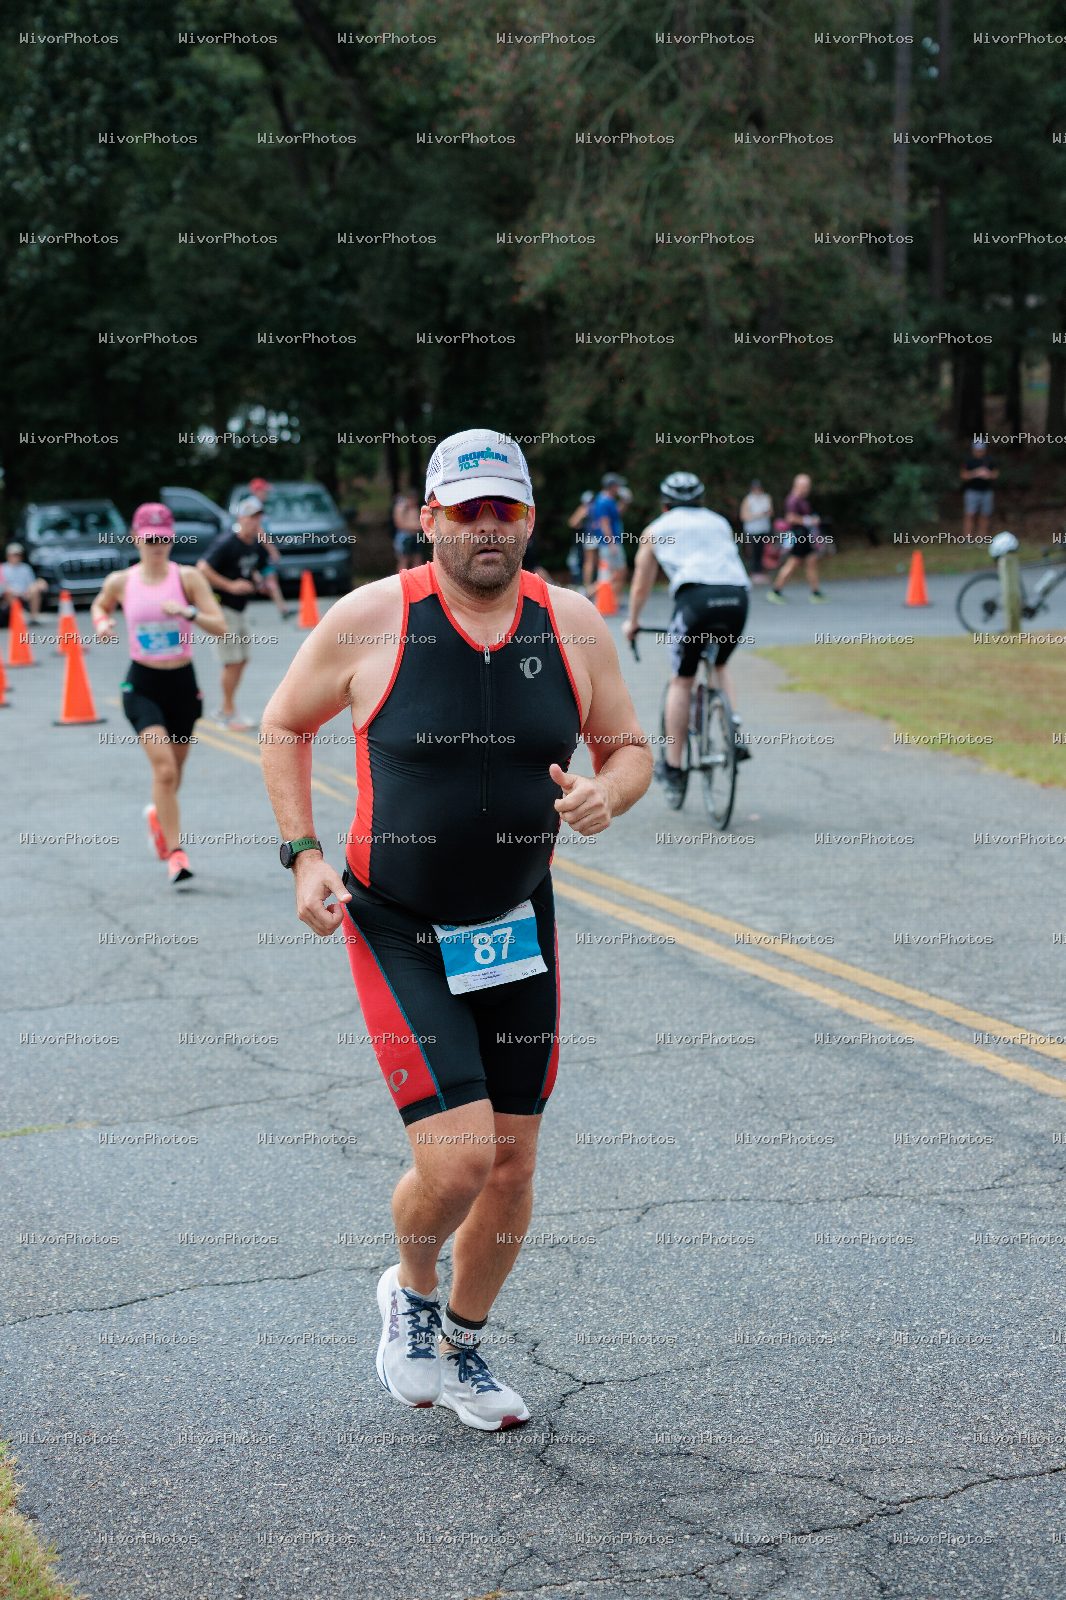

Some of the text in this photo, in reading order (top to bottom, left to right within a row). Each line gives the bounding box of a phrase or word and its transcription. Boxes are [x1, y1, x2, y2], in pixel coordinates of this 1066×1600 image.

[458, 447, 509, 464] IRONMAN
[459, 460, 479, 472] 70.3
[473, 926, 513, 965] 87
